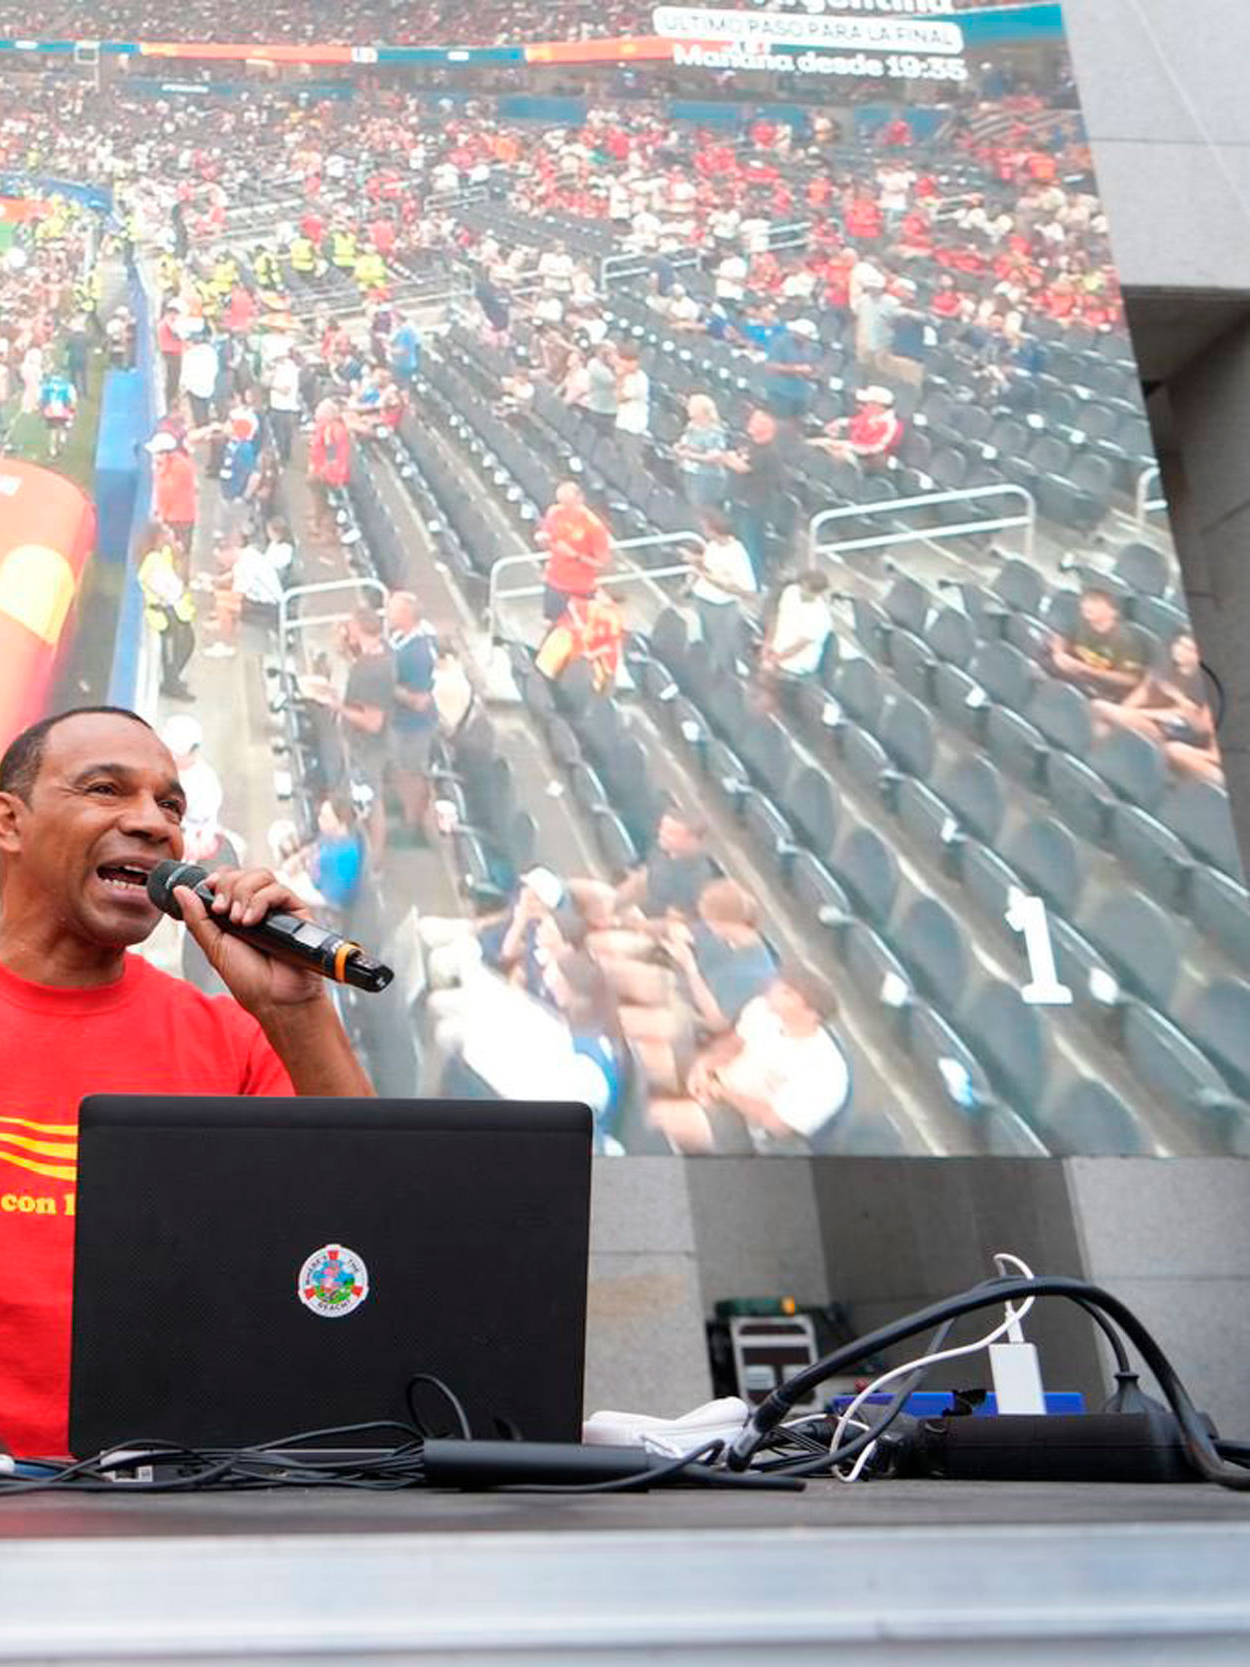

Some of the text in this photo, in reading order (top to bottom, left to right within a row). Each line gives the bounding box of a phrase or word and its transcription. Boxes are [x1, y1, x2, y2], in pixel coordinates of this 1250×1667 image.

[749, 19, 803, 37] PASO
[808, 21, 862, 40] PARA
[868, 25, 891, 41] LA
[896, 27, 954, 45] FINAL
[797, 51, 885, 77] desde
[885, 55, 969, 81] 19:35
[1, 1193, 57, 1216] con
